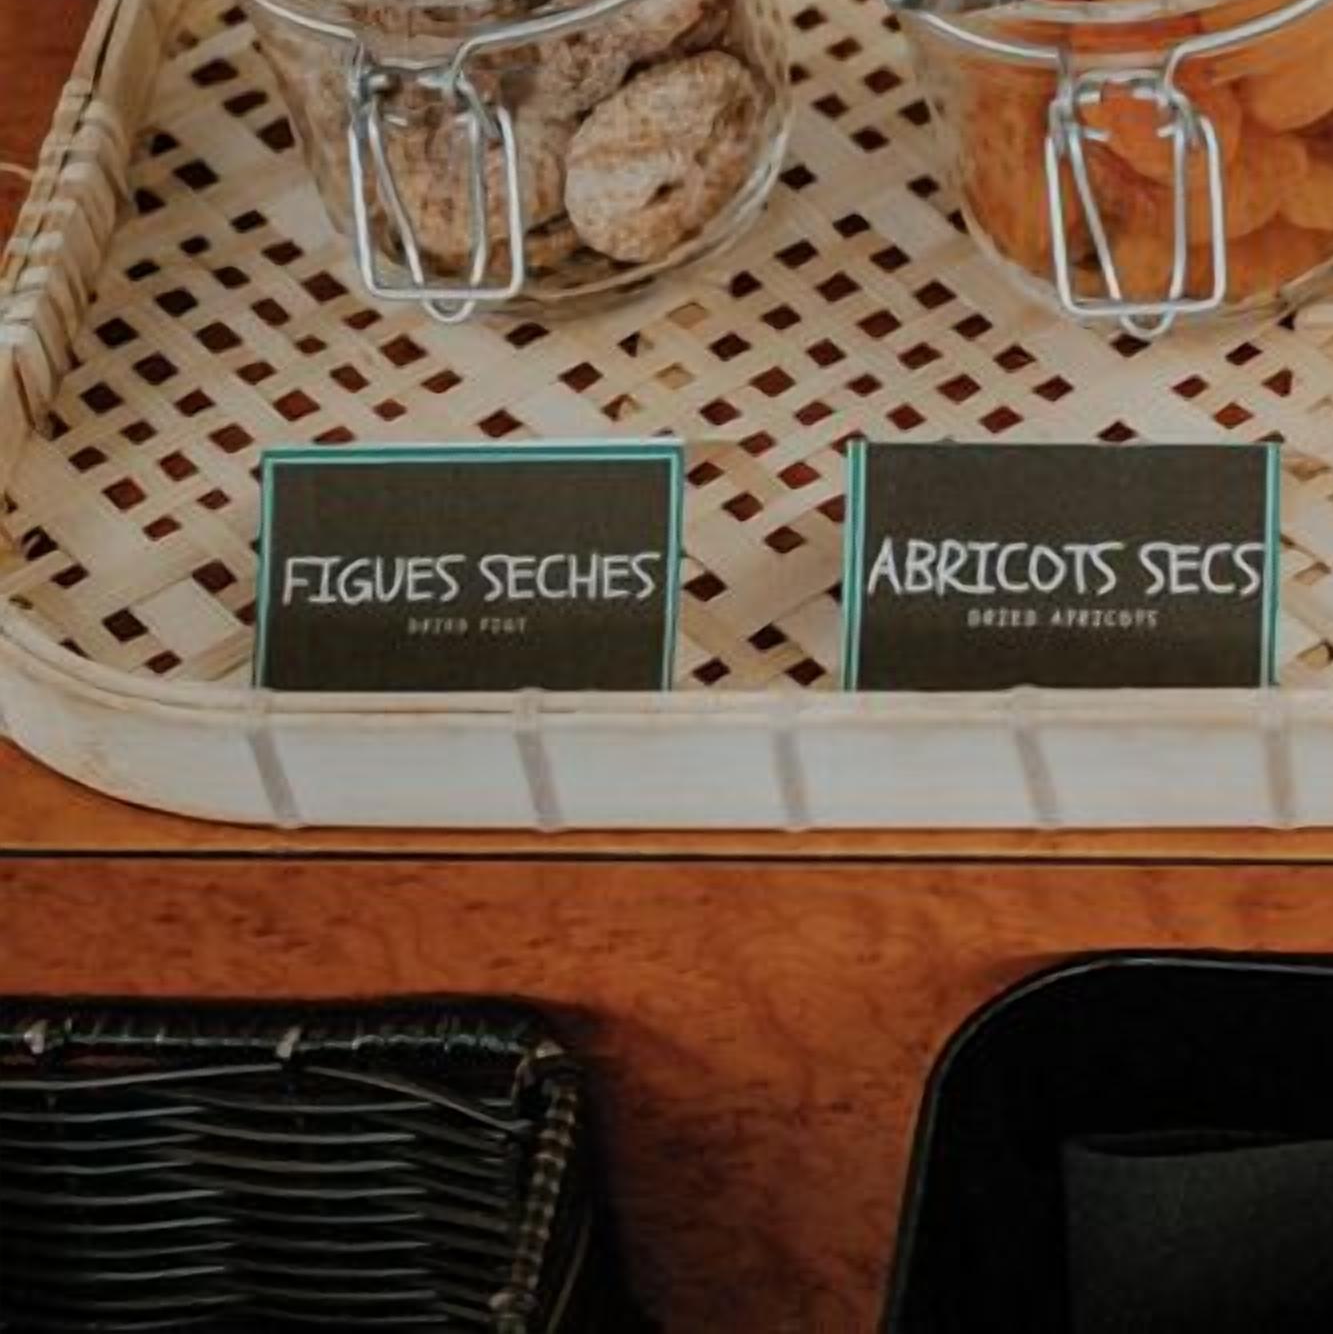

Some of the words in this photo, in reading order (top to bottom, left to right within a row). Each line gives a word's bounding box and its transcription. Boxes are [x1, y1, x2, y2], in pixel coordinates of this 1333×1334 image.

[282, 553, 466, 606] FIGUES
[478, 550, 661, 603] SECHES
[868, 536, 1126, 596] ABRICOTS
[1138, 541, 1265, 596] SECS
